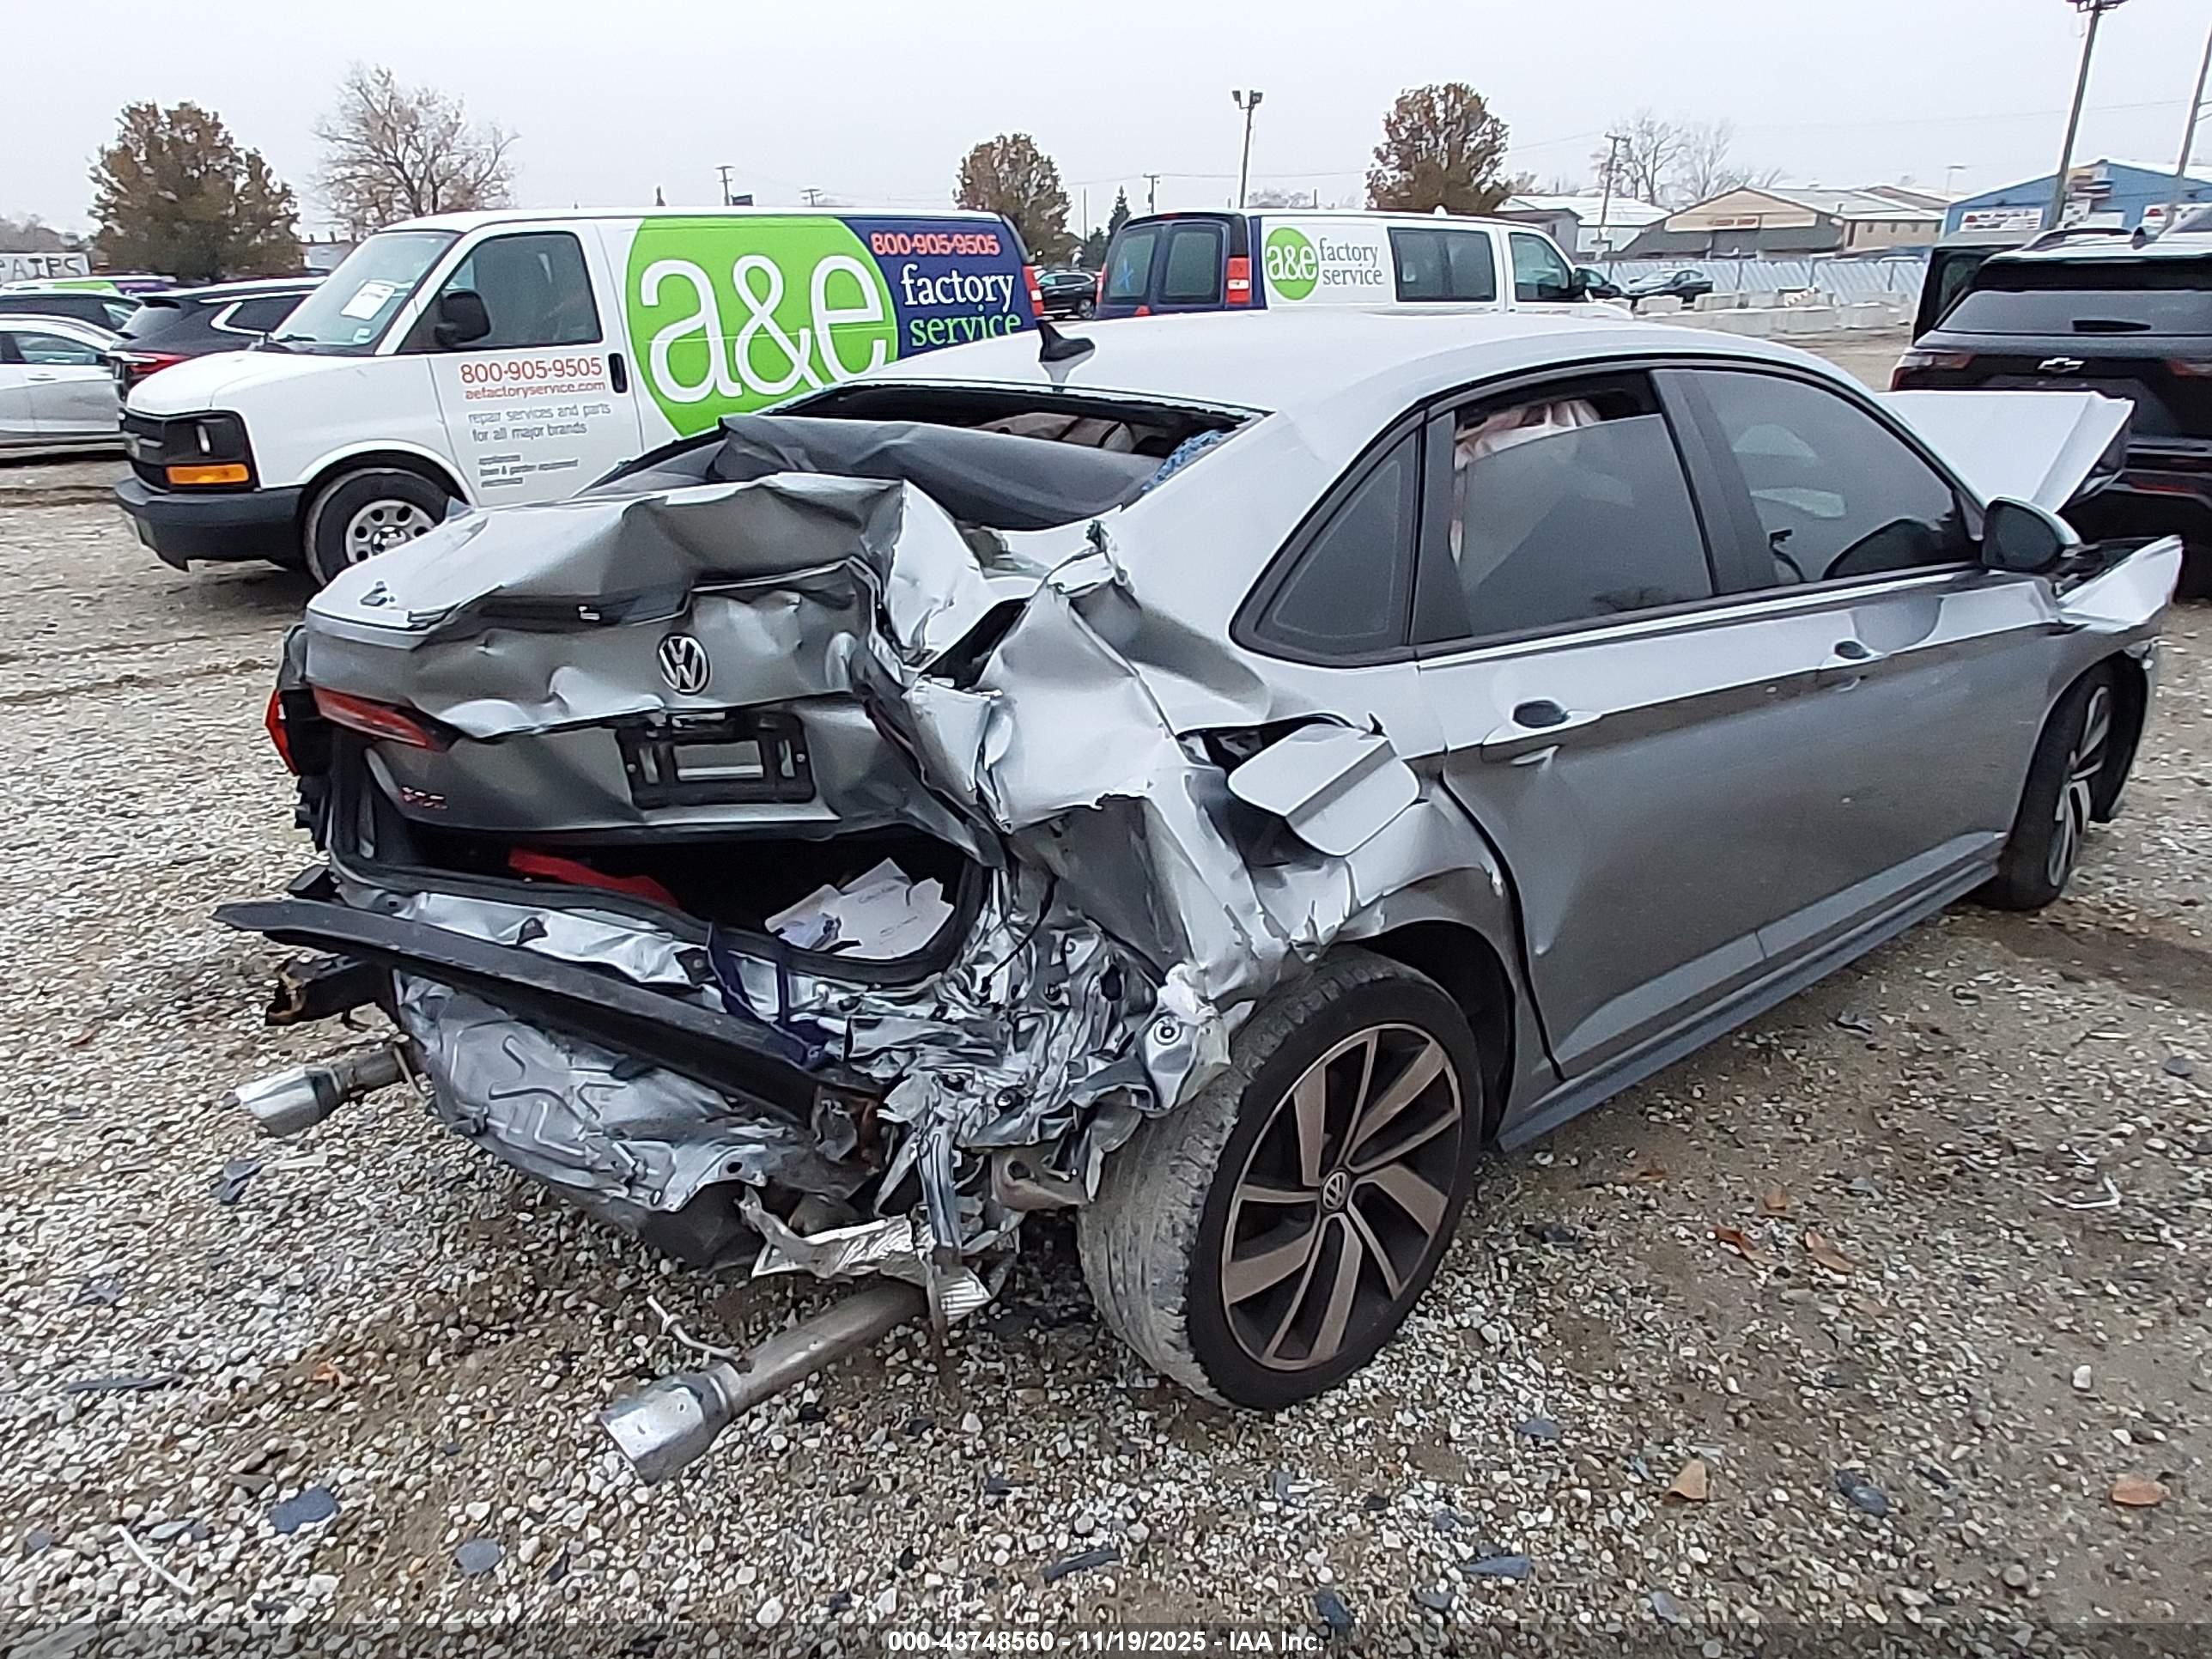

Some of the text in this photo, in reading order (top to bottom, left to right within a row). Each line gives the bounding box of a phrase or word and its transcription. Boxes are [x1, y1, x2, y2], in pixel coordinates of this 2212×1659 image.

[1266, 245, 1317, 281] a&e
[1319, 237, 1378, 268] factory
[900, 263, 1015, 313] factory
[1322, 263, 1384, 285] service
[640, 254, 885, 404] a&e
[910, 304, 1022, 346] service
[465, 381, 606, 399] aefactoryservice.com
[468, 403, 611, 425] repair services and parts
[473, 422, 587, 441] for all major brands
